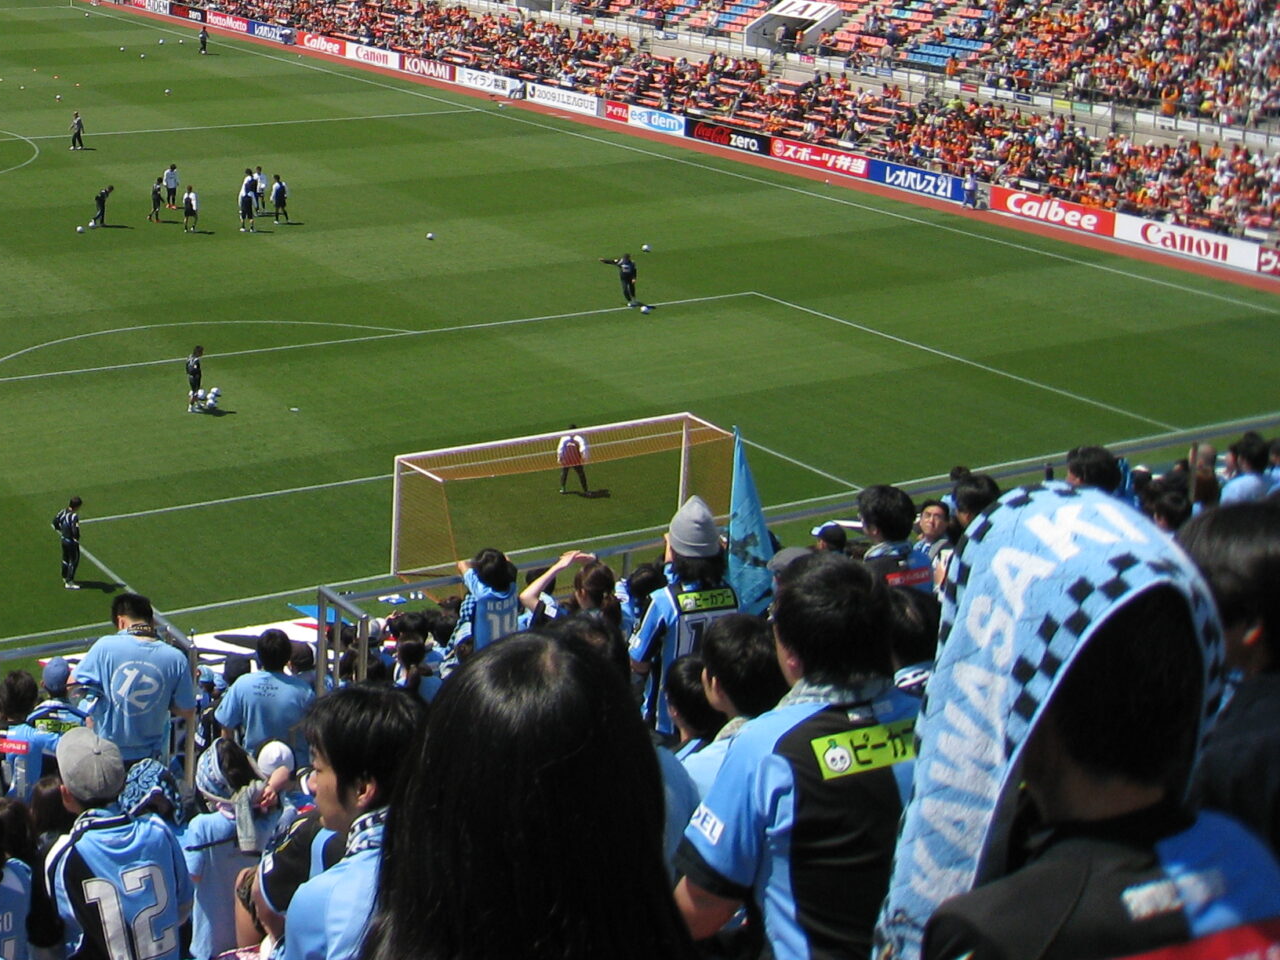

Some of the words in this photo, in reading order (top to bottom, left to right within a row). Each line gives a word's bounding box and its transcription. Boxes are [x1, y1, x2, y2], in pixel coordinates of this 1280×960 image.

[777, 1, 828, 17] IAI
[303, 34, 340, 54] Calbee
[355, 45, 388, 65] Canon
[404, 56, 450, 79] KONAMI
[784, 144, 867, 174] スポーツ弁当
[885, 166, 952, 198] レオパレス21
[1006, 193, 1098, 230] Calbee
[1140, 222, 1228, 261] Canon
[117, 668, 159, 709] 12
[911, 502, 1147, 901] KAWASAKI
[82, 864, 177, 960] 12
